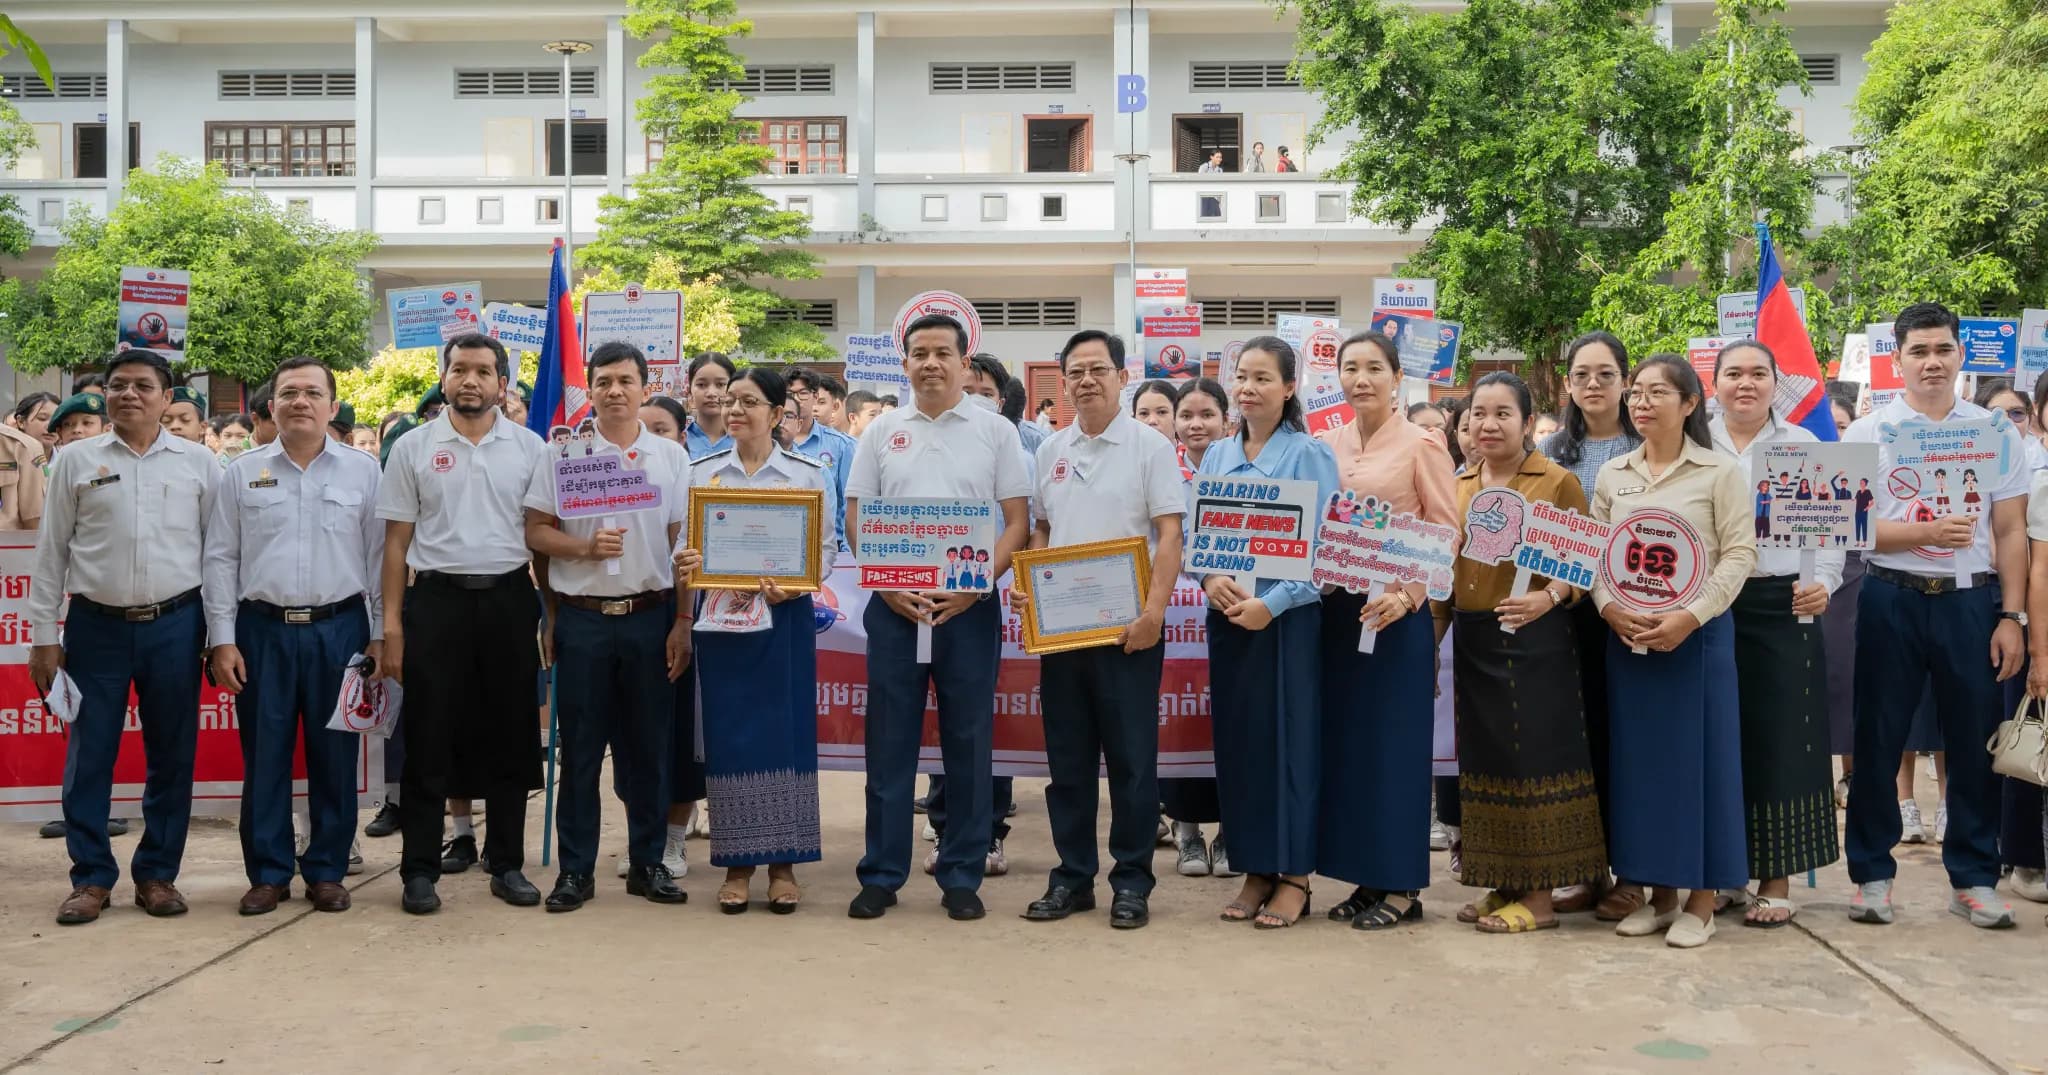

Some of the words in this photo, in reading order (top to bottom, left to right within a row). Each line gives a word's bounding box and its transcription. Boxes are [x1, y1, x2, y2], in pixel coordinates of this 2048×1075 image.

[1118, 74, 1147, 113] B
[560, 459, 617, 474] ទាំងអស់គ្នា
[1197, 481, 1280, 500] SHARING
[1201, 511, 1244, 529] FAKE
[1245, 514, 1296, 533] NEWS
[1635, 523, 1677, 539] និយាយថា
[1192, 534, 1210, 549] IS
[1213, 535, 1249, 553] NOT
[1191, 552, 1256, 572] CARING
[1517, 545, 1593, 588] ព័ត៌មានពិត
[867, 571, 896, 583] FAKE
[898, 571, 933, 584] NEWS
[1637, 573, 1663, 587] ចំពោះ
